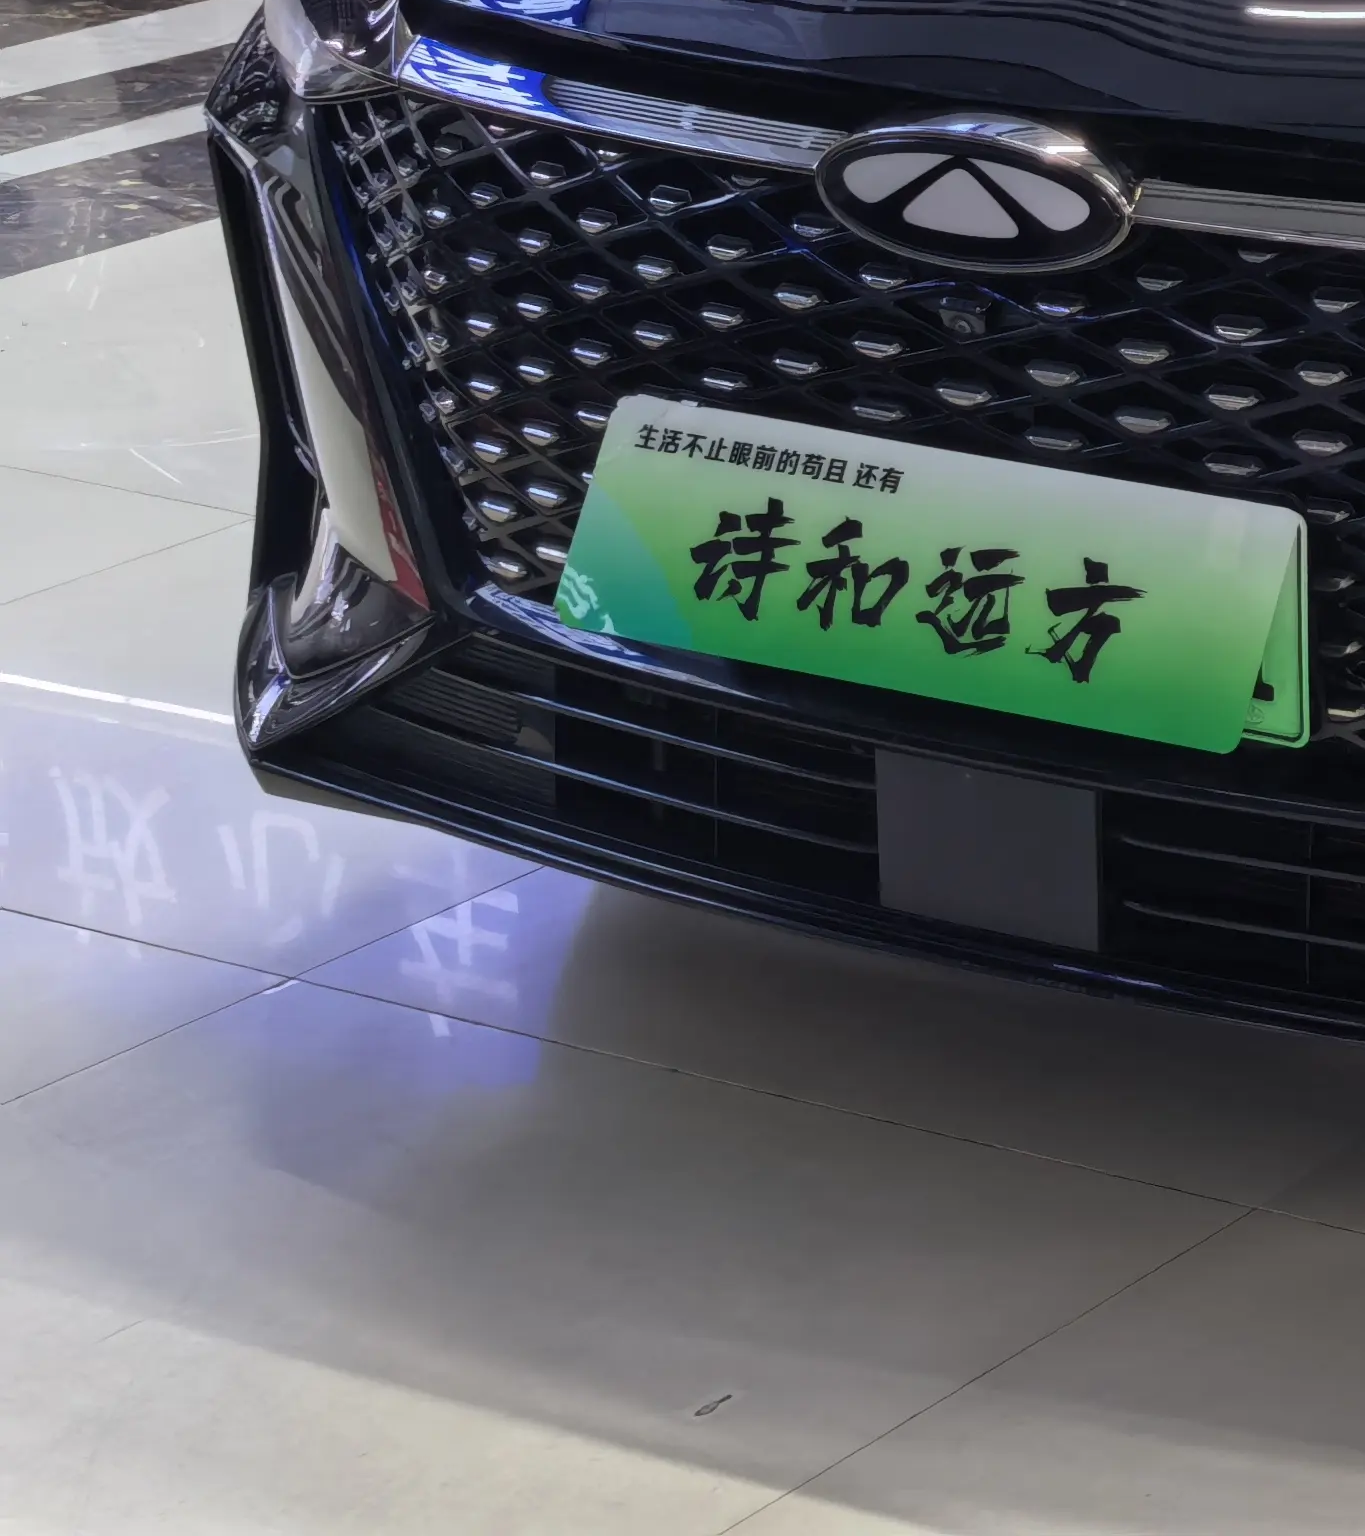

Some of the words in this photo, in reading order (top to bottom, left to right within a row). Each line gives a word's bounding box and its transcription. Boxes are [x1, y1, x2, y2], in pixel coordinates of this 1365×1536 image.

[634, 423, 849, 484] 生活不止眼前的苟且
[852, 461, 905, 495] 还有
[688, 496, 1148, 683] 诗和远方
